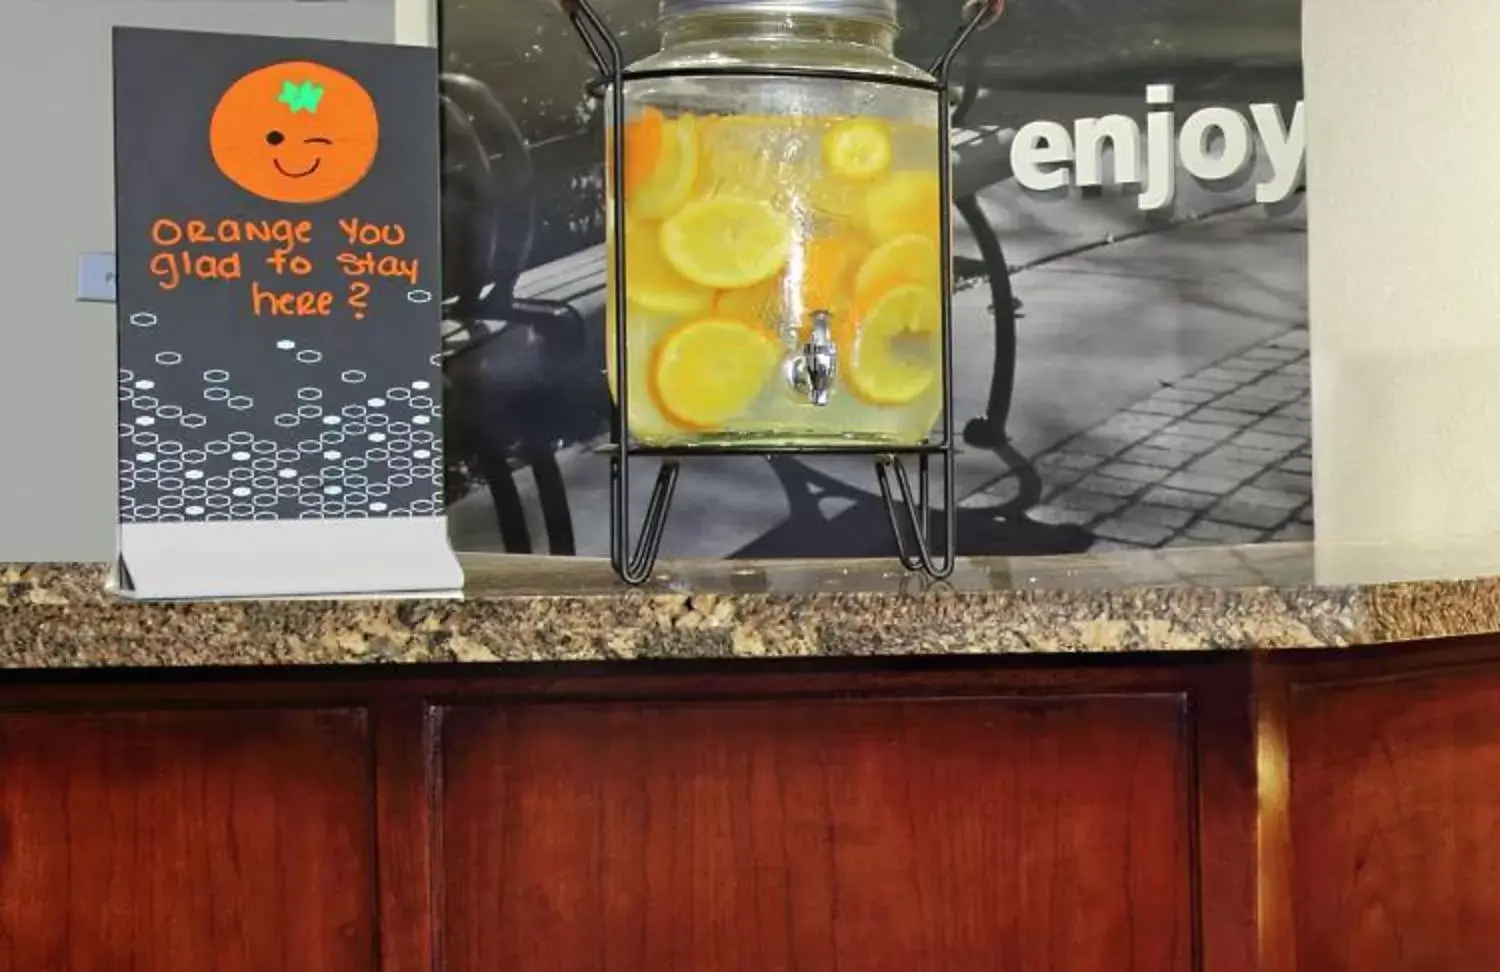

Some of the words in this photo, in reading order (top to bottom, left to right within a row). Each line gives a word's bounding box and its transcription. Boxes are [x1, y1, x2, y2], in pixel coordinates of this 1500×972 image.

[1009, 83, 1306, 211] enjoy
[150, 252, 241, 289] glad
[267, 252, 312, 275] to
